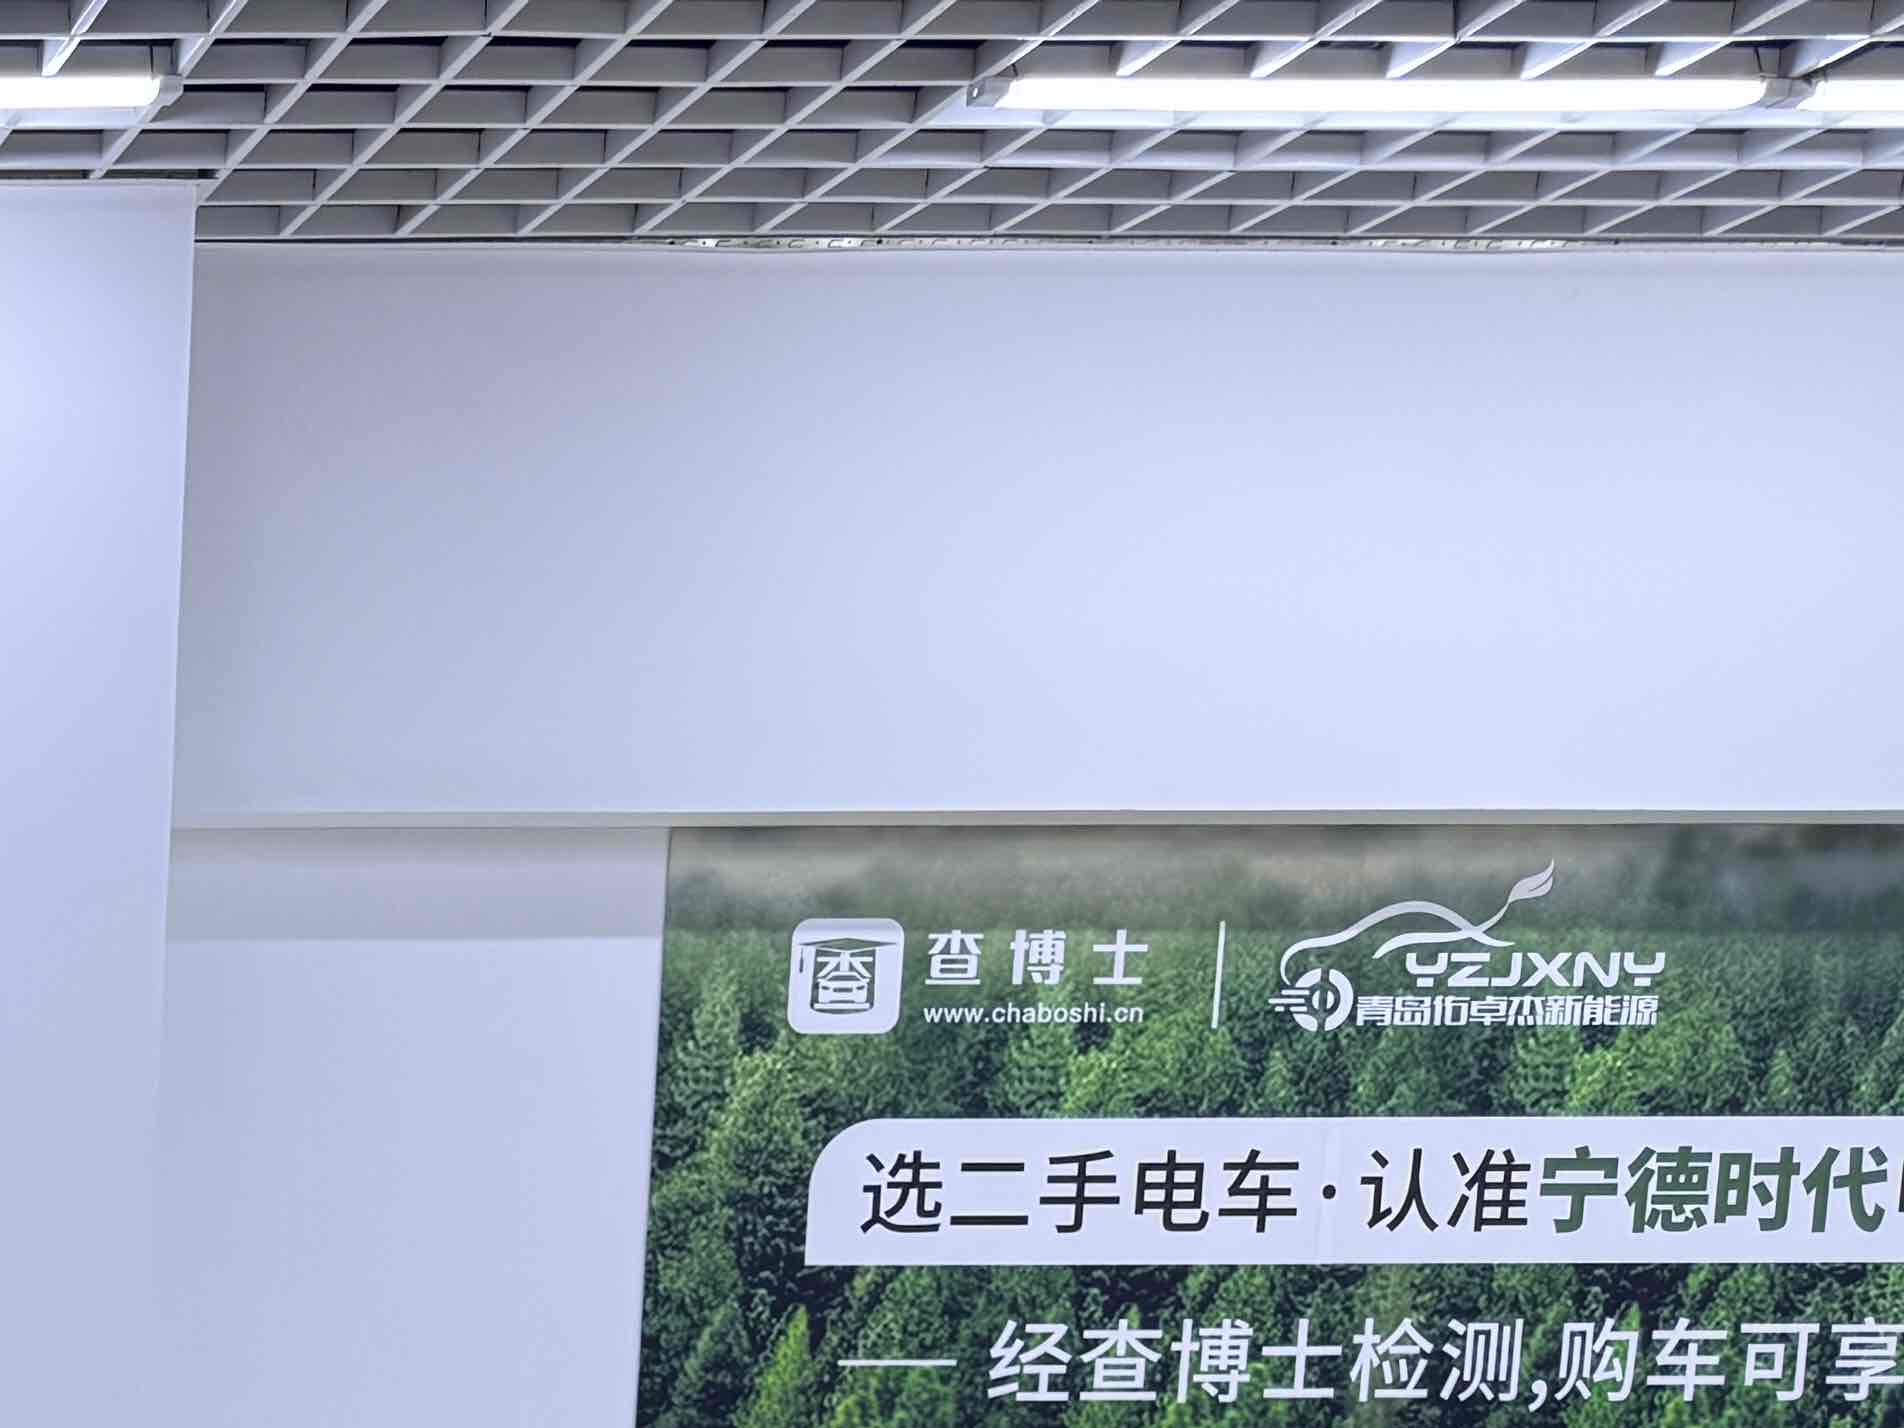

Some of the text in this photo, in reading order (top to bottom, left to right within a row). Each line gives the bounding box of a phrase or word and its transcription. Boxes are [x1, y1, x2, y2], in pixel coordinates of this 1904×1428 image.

[925, 929, 1148, 985] 查博士
[1405, 952, 1666, 988] YZJXNY
[923, 1002, 1144, 1025] www.chaboshi.cn
[1355, 995, 1660, 1026] 青岛佑卓杰新能源
[862, 1145, 1904, 1235] 选二手电车·认准宁德时代
